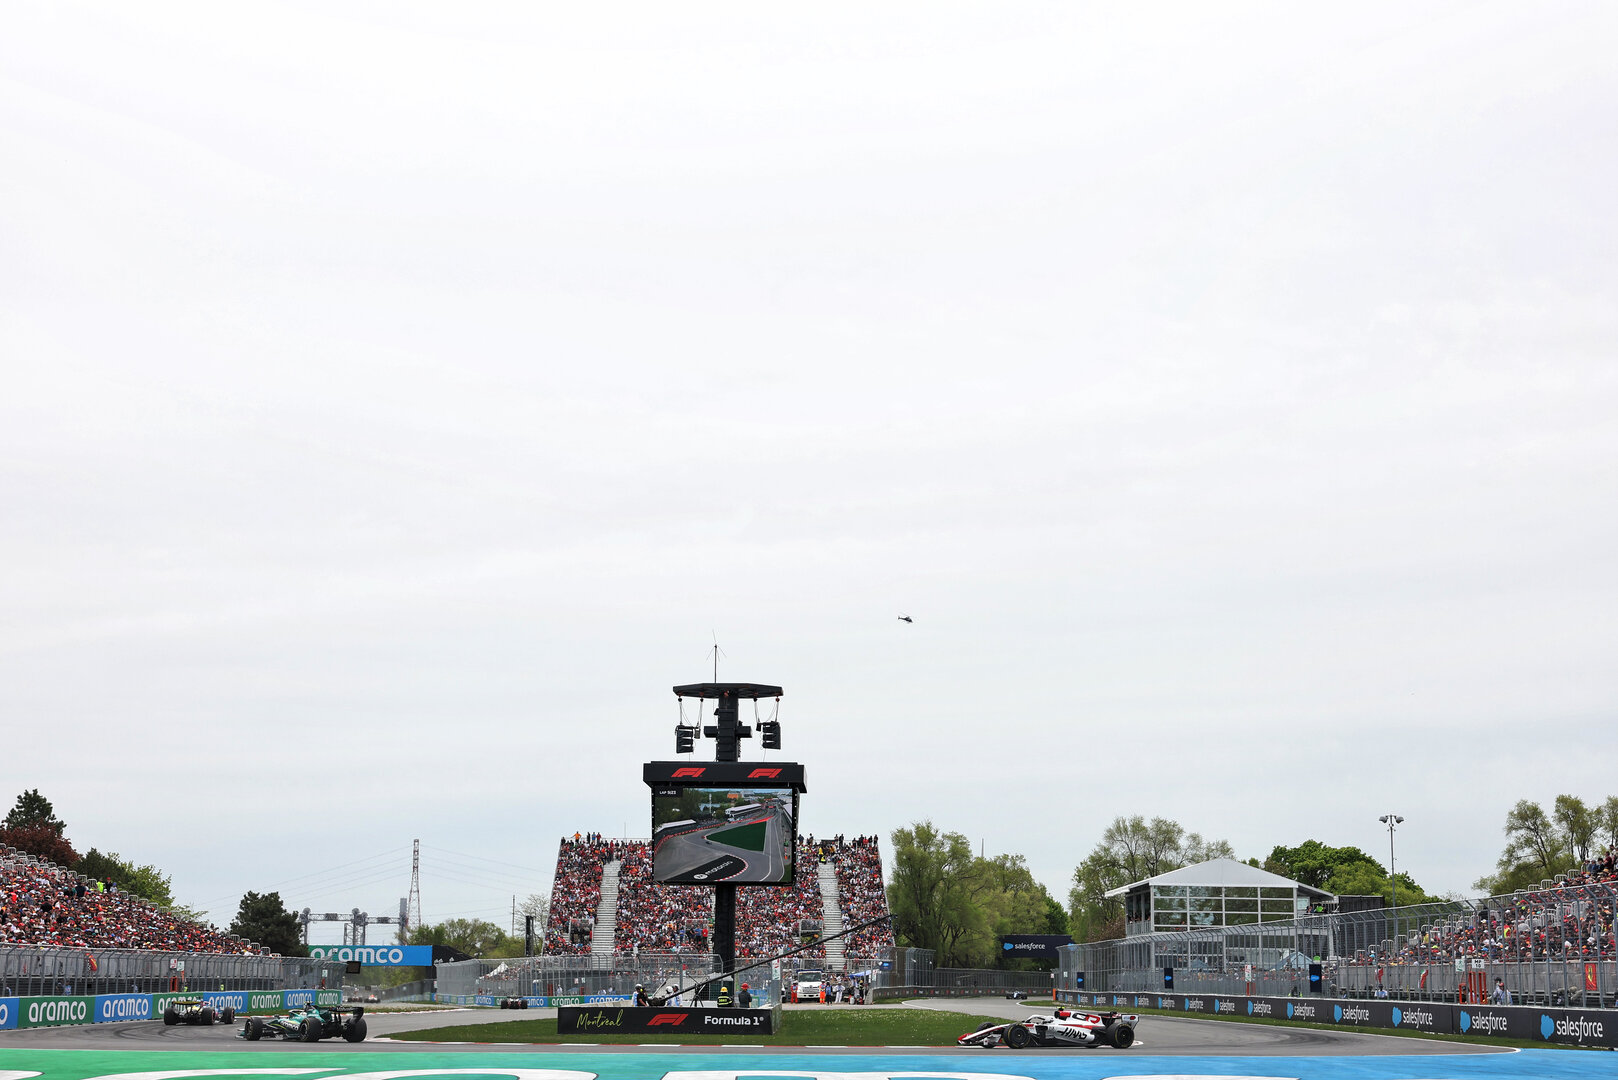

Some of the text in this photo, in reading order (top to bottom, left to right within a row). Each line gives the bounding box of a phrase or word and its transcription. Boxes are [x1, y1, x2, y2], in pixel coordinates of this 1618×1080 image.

[1014, 942, 1046, 951] salesforce
[102, 998, 149, 1018] aramco
[251, 994, 281, 1009] aramco
[317, 992, 339, 1005] aramco
[28, 1001, 87, 1023] aramco
[704, 1015, 751, 1026] Formula
[1293, 1002, 1316, 1020] salesforce
[1342, 1004, 1370, 1024] salesforce
[1402, 1008, 1433, 1028] salesforce
[1471, 1011, 1508, 1035] salesforce
[1556, 1015, 1604, 1042] salesforce
